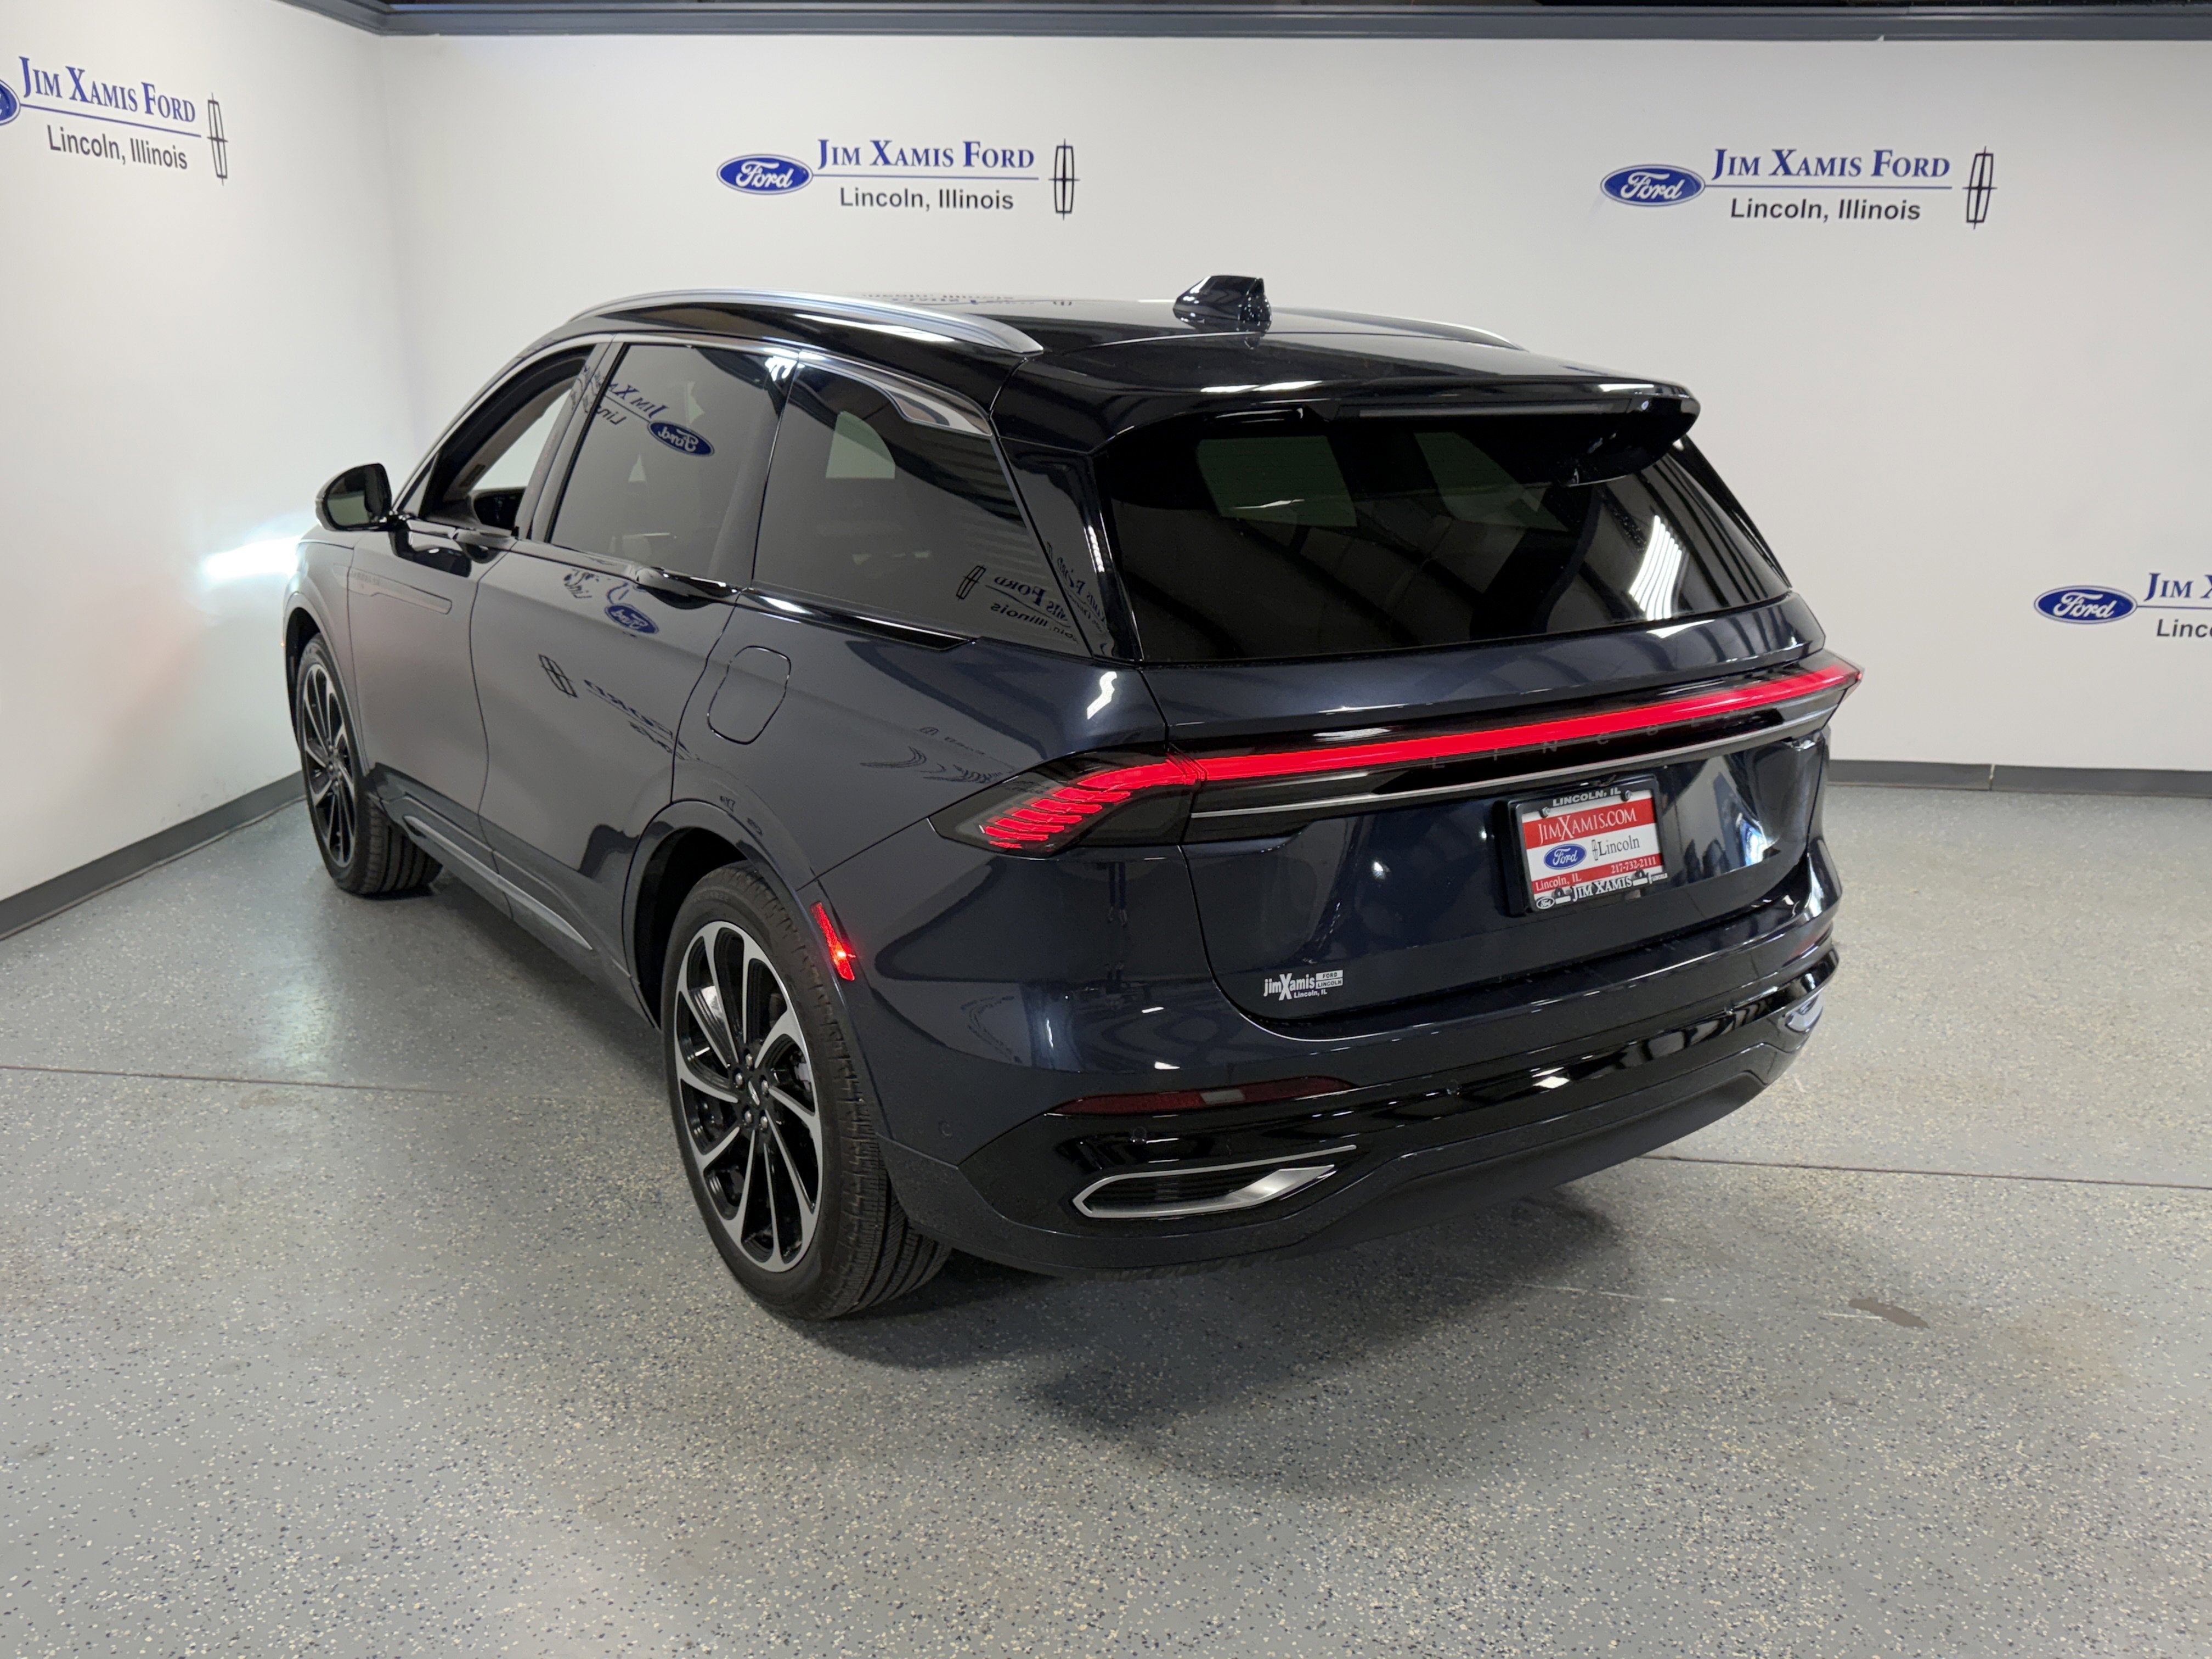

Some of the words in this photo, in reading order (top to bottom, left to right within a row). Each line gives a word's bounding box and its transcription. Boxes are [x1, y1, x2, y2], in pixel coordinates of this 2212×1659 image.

[19, 57, 63, 98] JIM
[65, 66, 138, 112] XAMIS
[141, 82, 196, 122] FORD
[47, 125, 125, 165] Lincoln,
[130, 138, 187, 170] Illinois
[818, 139, 860, 170] JIM
[870, 140, 954, 167] XAMIS
[963, 141, 1035, 168] FORD
[736, 160, 793, 189] Ford
[1712, 149, 1760, 180] JIM
[1770, 149, 1861, 177] XAMIS
[1871, 150, 1950, 177] FORD
[1621, 171, 1683, 200] Ford
[840, 188, 930, 211] Lincoln,
[939, 189, 1014, 210] Illinois
[1731, 198, 1829, 222] Lincoln,
[1838, 199, 1920, 219] Illinois
[2144, 573, 2194, 601] JIM
[2053, 592, 2116, 618] Ford
[2157, 619, 2212, 638] Linc
[1553, 789, 1606, 807] LINCOLN,
[1611, 787, 1621, 795] IL
[1538, 808, 1637, 845] JIMXAMIS.COM
[1553, 848, 1578, 866] Ford
[1598, 835, 1640, 856] Lincoln
[1611, 856, 1657, 874] 217-732-2111
[1536, 876, 1570, 891] Lincoln,
[1572, 873, 1582, 883] IL
[1572, 884, 1593, 902] JIM
[1594, 876, 1633, 895] XAMIS
[1294, 990, 1320, 998] Lincoln,
